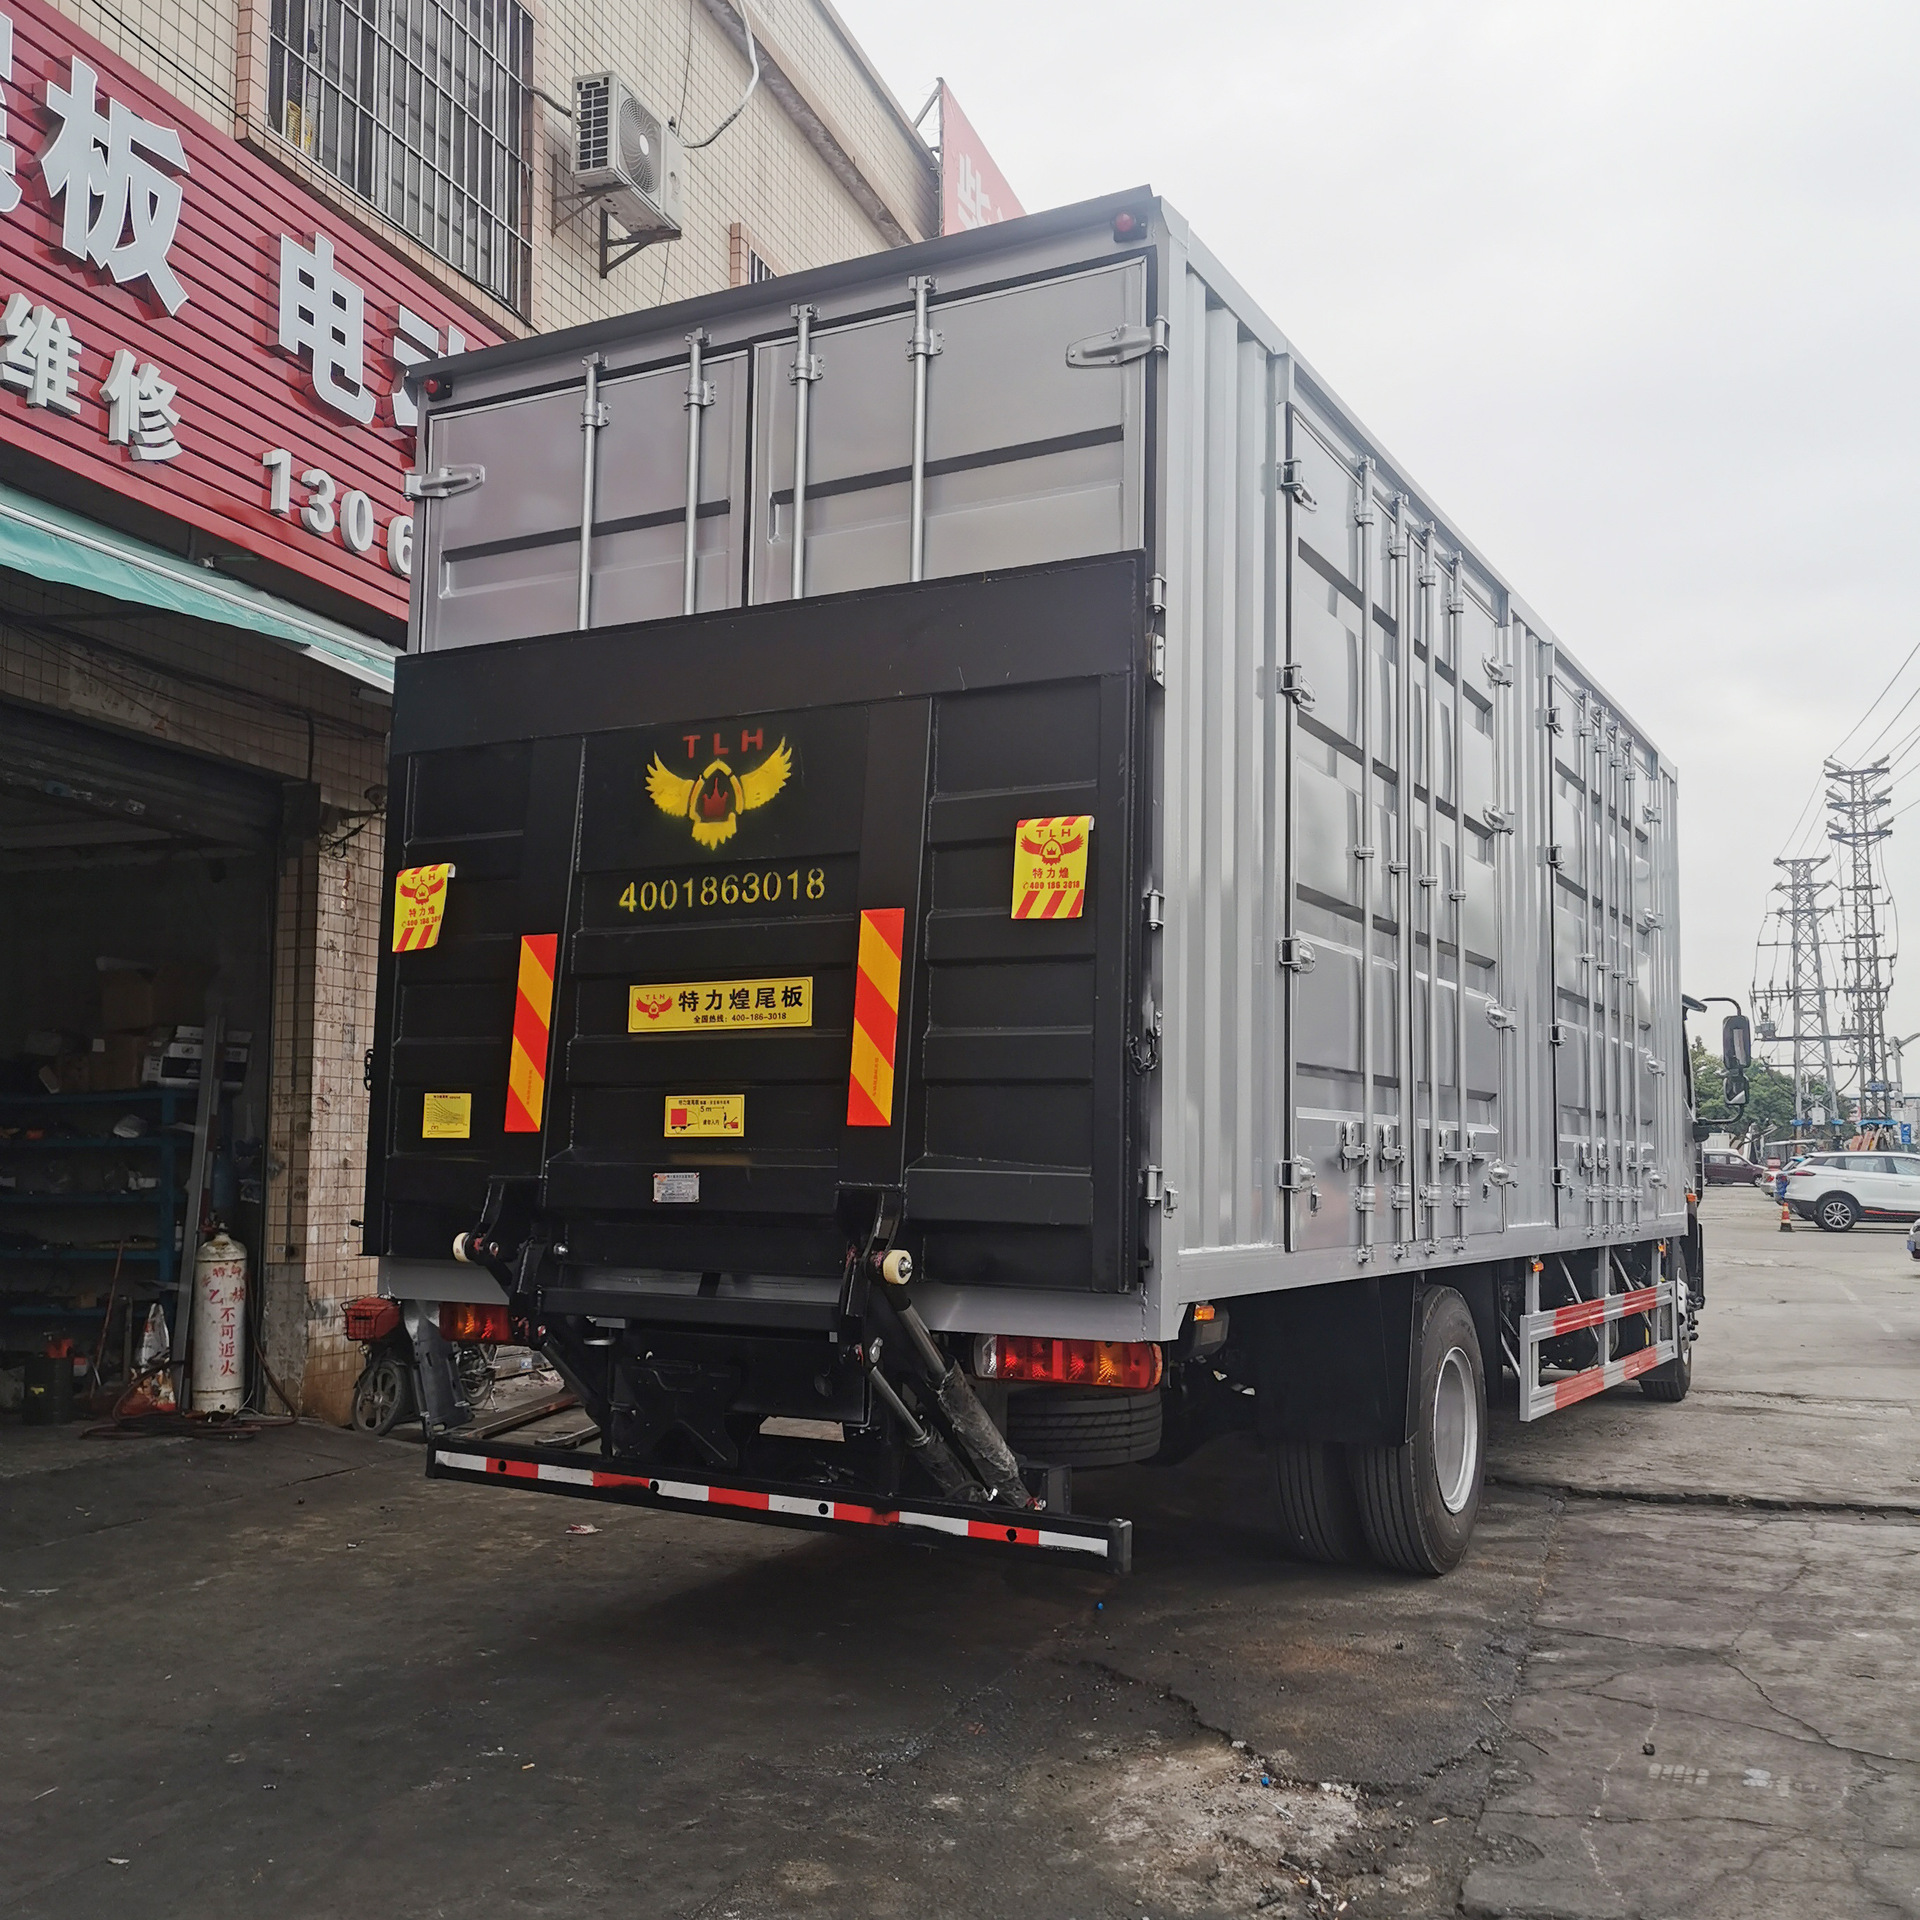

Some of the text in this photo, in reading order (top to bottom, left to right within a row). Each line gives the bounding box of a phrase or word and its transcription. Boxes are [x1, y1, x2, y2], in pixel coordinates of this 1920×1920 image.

[0, 292, 183, 461] 维修
[262, 449, 412, 575] 1306
[683, 728, 763, 759] TLH
[1036, 829, 1070, 837] TLH
[411, 874, 435, 883] TLH
[619, 868, 825, 913] 4001863018
[678, 985, 804, 1012] 特力煌尾板
